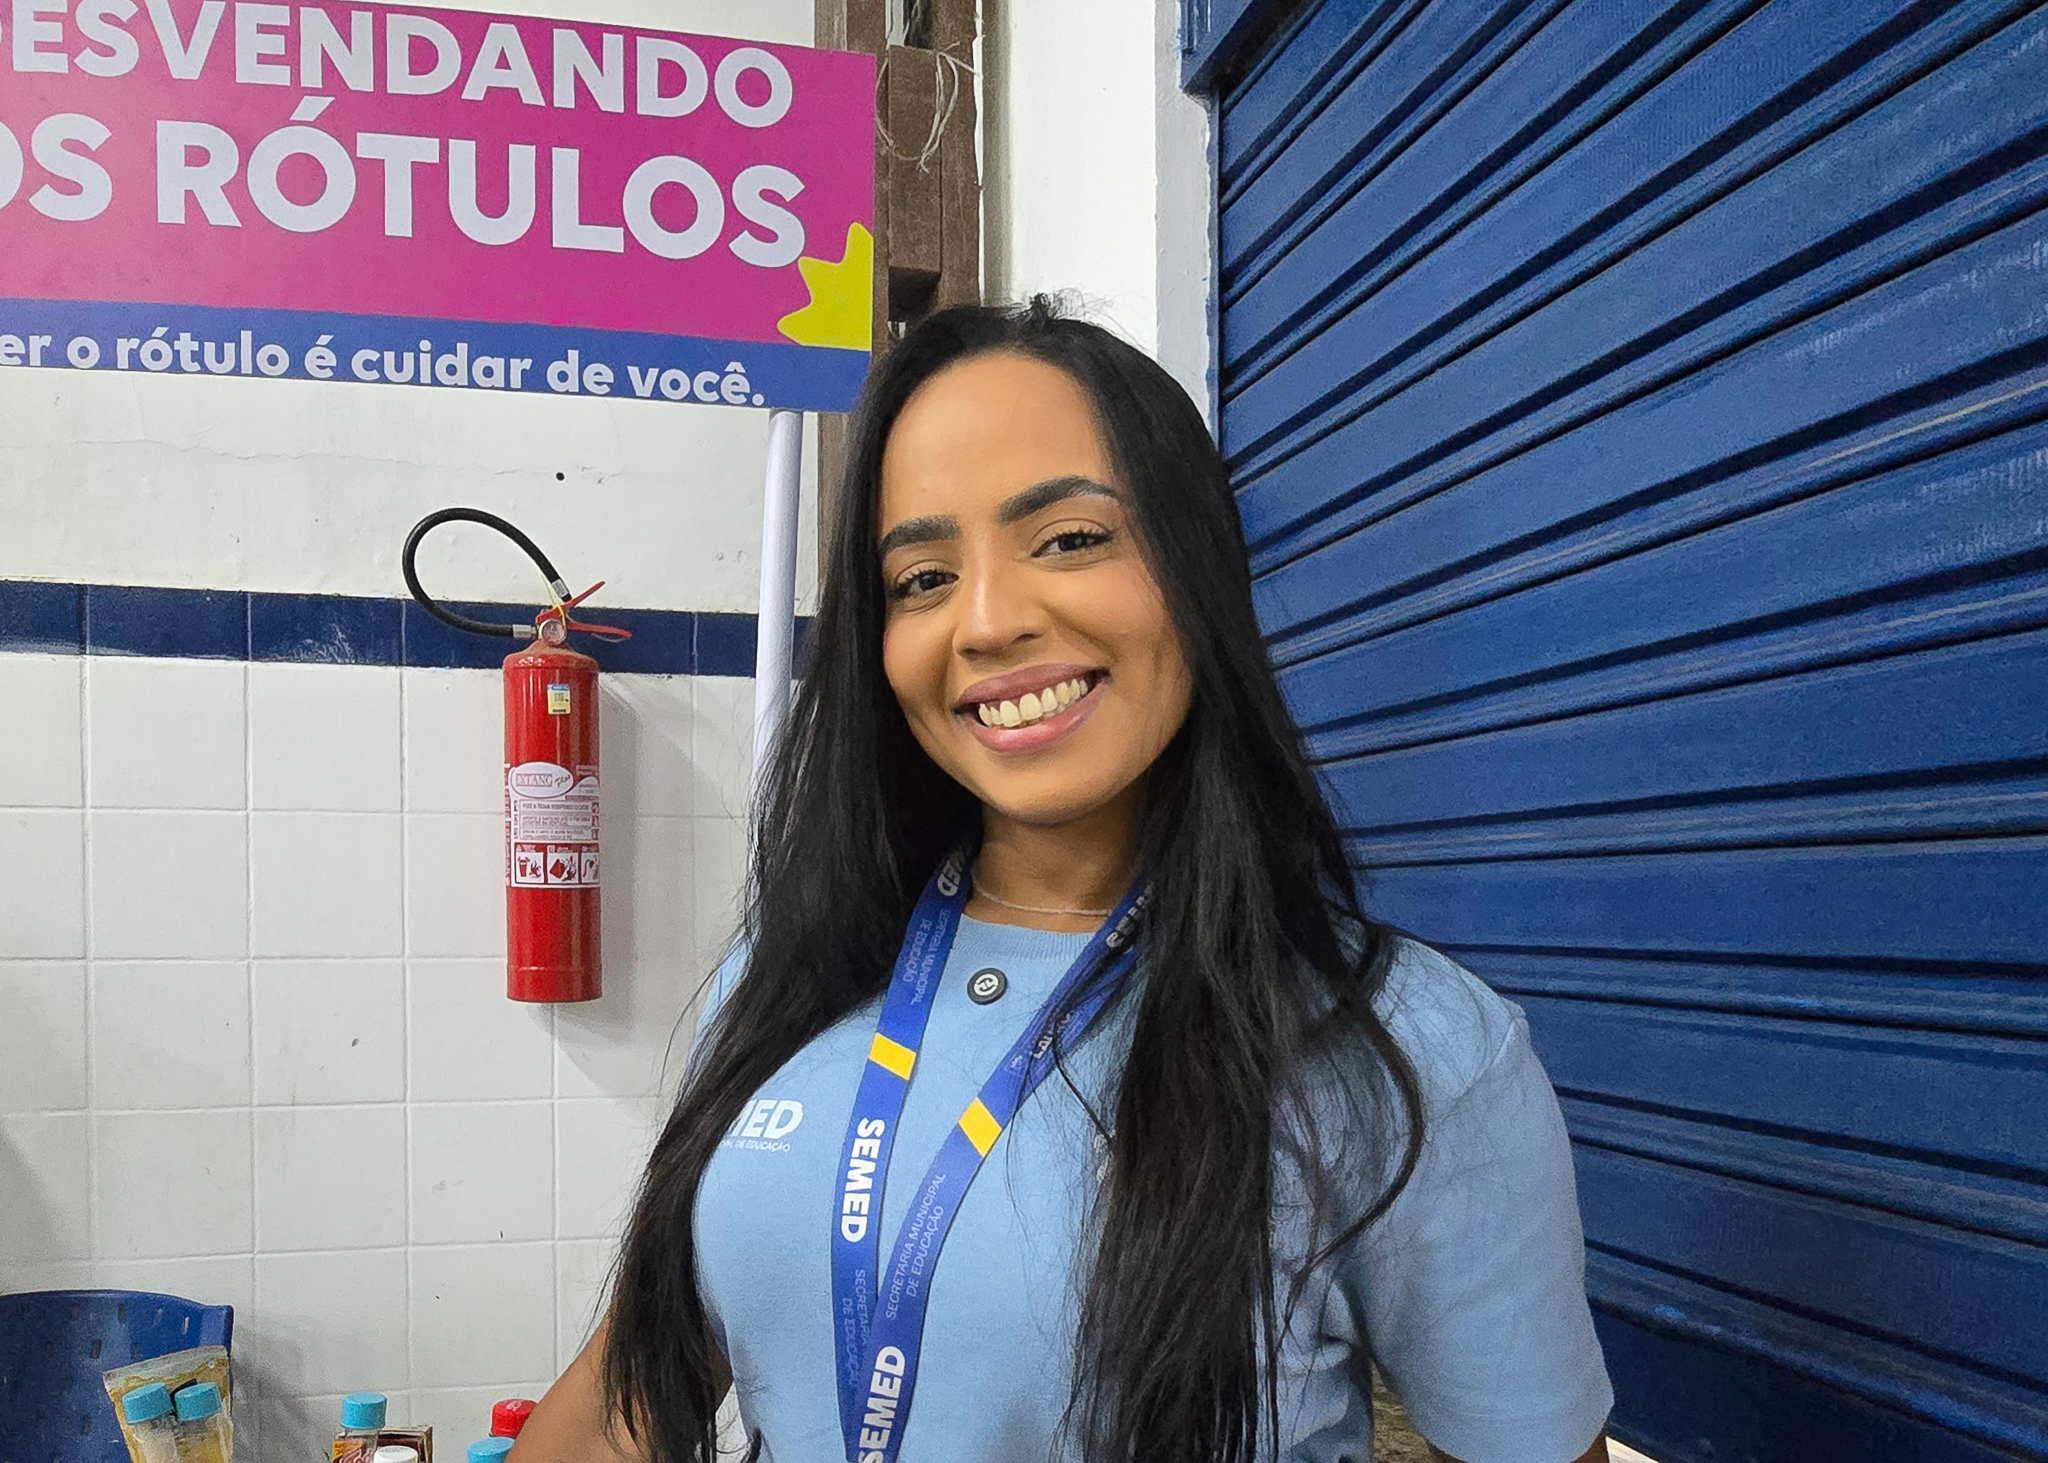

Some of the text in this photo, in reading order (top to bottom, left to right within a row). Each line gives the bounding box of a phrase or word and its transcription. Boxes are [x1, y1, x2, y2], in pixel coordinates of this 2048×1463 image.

[0, 0, 793, 129] ESVENDANDO
[0, 96, 806, 268] S RÓTULOS
[67, 336, 100, 369] o
[116, 326, 290, 377] rótulo
[304, 334, 337, 379] é
[351, 340, 532, 389] cuidar
[546, 350, 615, 395] de
[626, 361, 765, 406] você.
[841, 1117, 886, 1243] SEMED
[885, 1172, 946, 1321] SECRETARIA MUNICIPAL
[905, 1205, 944, 1297] DE EDUCAÇÃO
